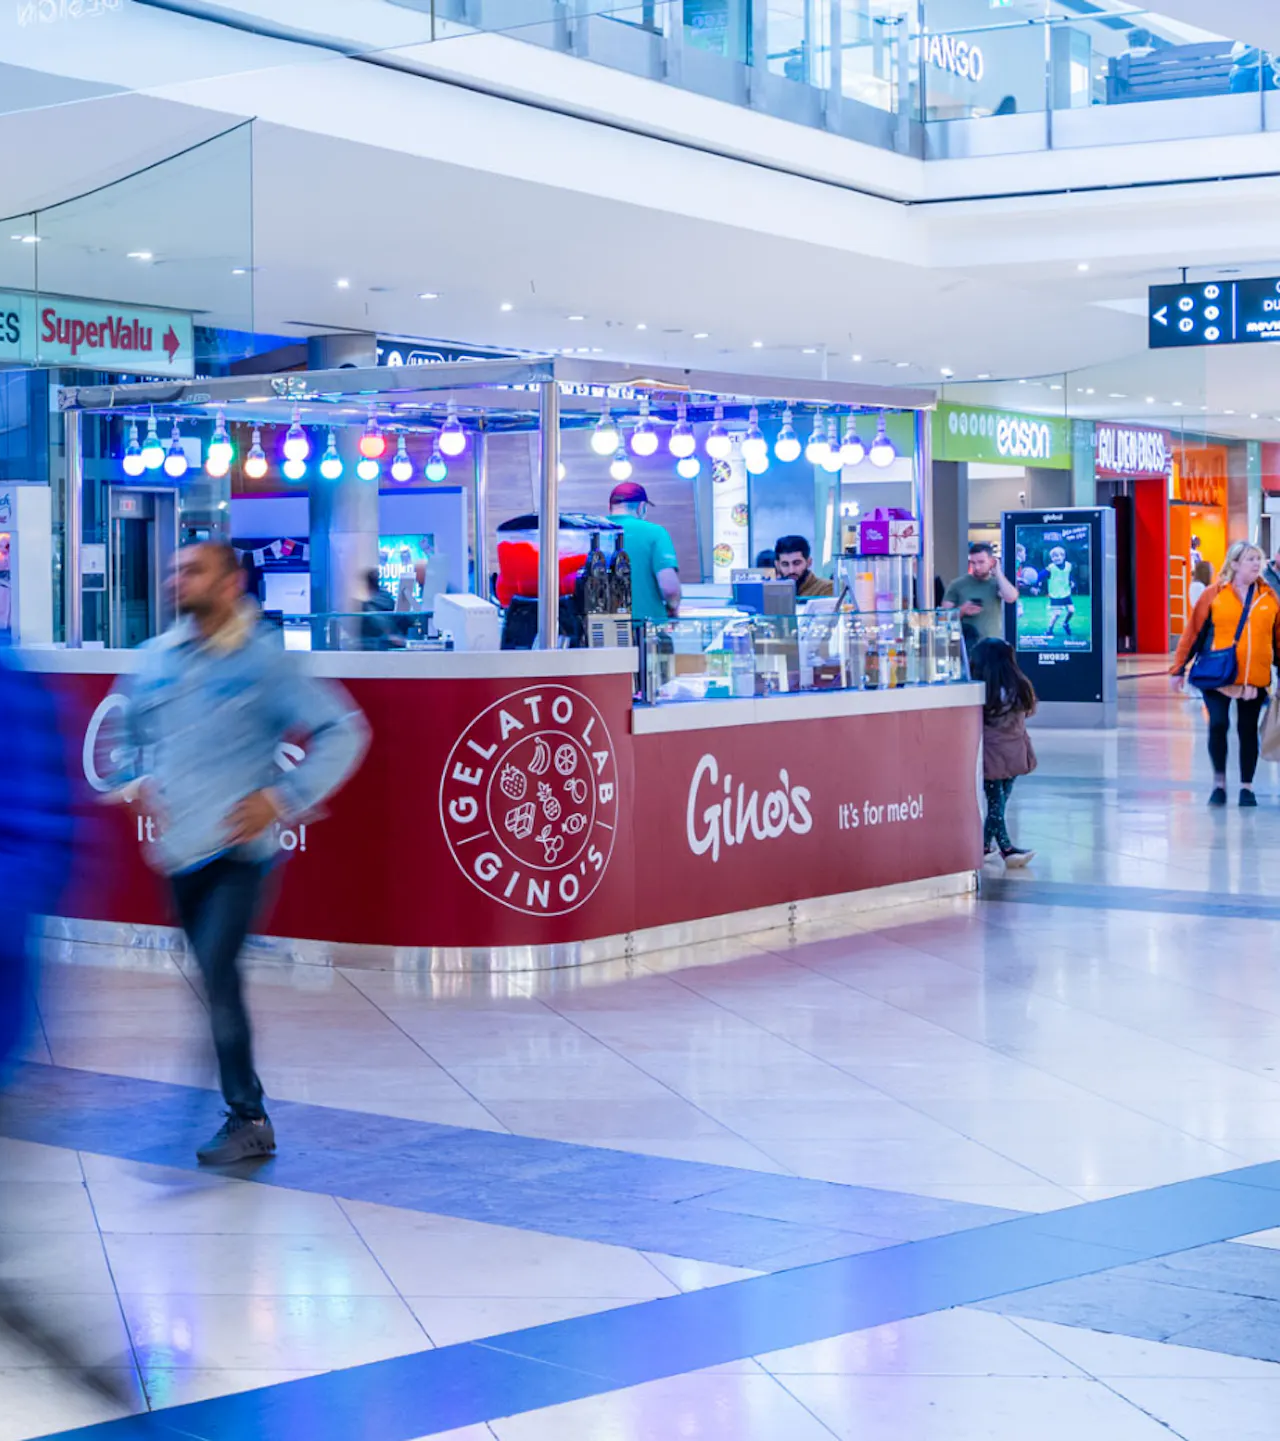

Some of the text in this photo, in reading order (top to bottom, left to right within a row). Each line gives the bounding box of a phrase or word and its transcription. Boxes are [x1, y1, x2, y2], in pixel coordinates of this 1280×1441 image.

[41, 307, 153, 356] SuperValu
[996, 418, 1051, 459] eason
[449, 695, 614, 823] GELATO LAB
[686, 753, 813, 862] Gino's
[839, 802, 860, 830] It's
[863, 800, 883, 826] for
[474, 845, 604, 908] GINO'S
